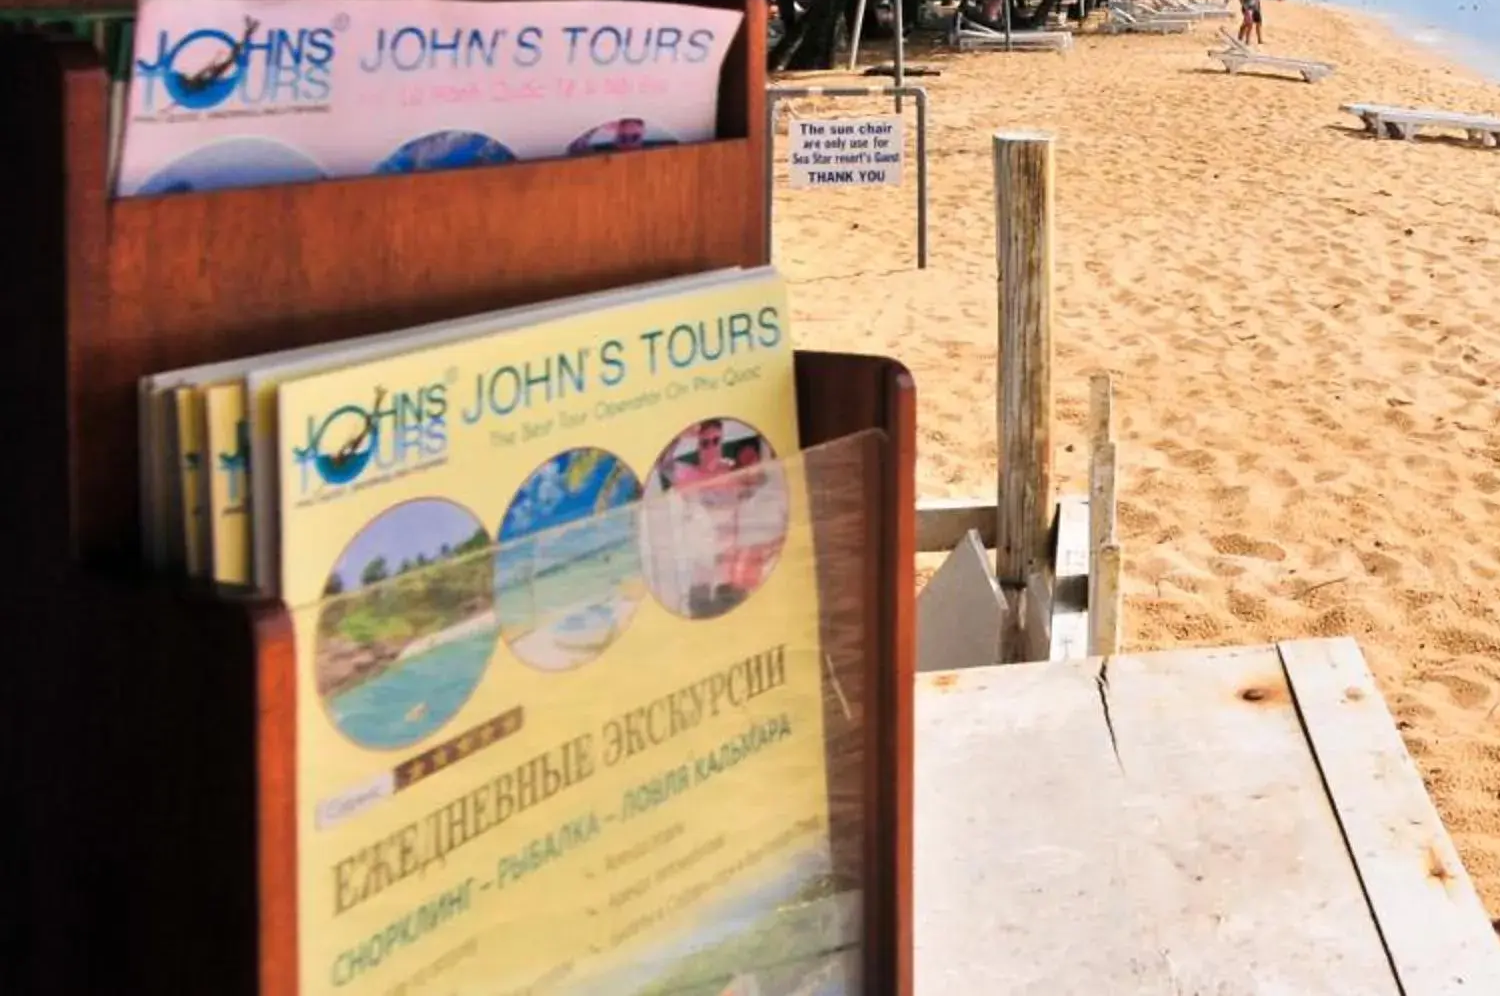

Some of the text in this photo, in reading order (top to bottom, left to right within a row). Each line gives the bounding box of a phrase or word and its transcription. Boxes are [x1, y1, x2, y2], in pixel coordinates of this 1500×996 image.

[136, 27, 335, 76] JOHNS
[360, 25, 715, 73] JOHN'S TOURS
[800, 122, 893, 135] The sun chair
[803, 136, 889, 151] are only use for
[793, 152, 809, 164] Sea
[812, 152, 832, 164] Star
[808, 169, 886, 183] THANK YOU
[462, 306, 782, 426] JOHN'S TOURS
[332, 732, 595, 919] ЕЖЕДНЕВНЫЕ
[602, 643, 787, 767] ЭКСКУРСИИ
[497, 810, 600, 890] РЫБАЛКА
